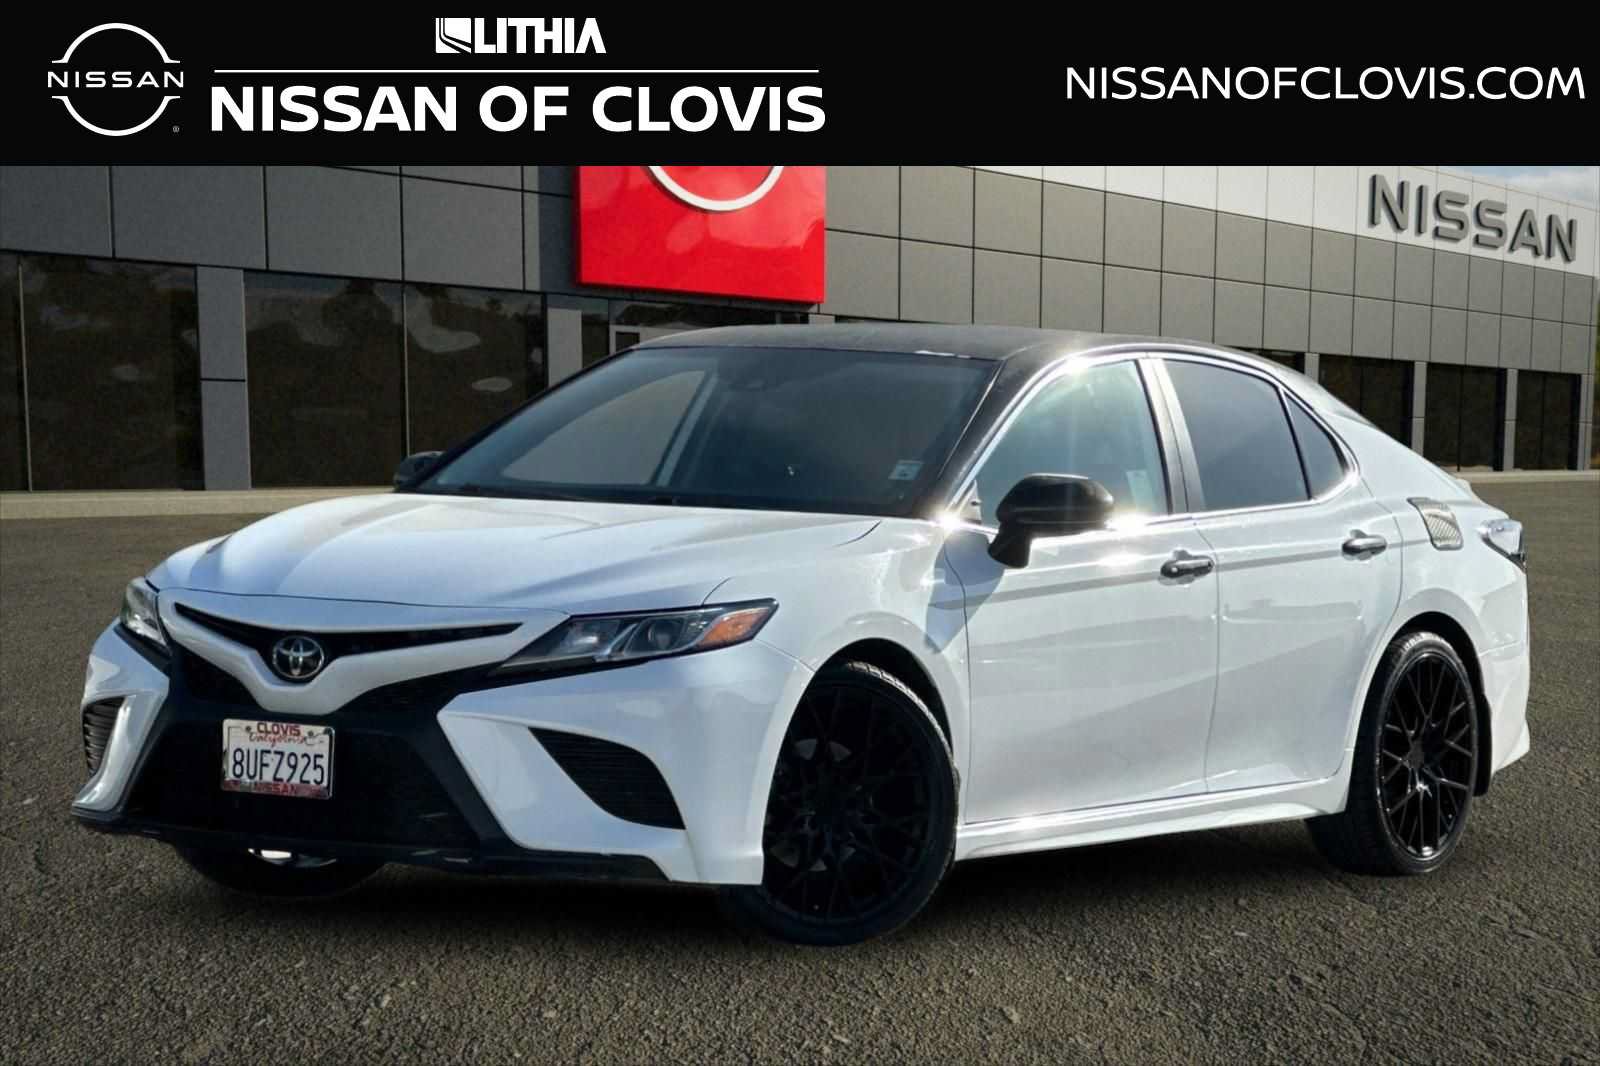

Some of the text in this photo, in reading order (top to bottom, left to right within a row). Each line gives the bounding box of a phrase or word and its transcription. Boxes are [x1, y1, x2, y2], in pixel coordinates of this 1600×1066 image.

[1367, 173, 1578, 263] NISSAN
[256, 722, 302, 737] CLOVIS
[232, 747, 325, 785] 8UFZ925
